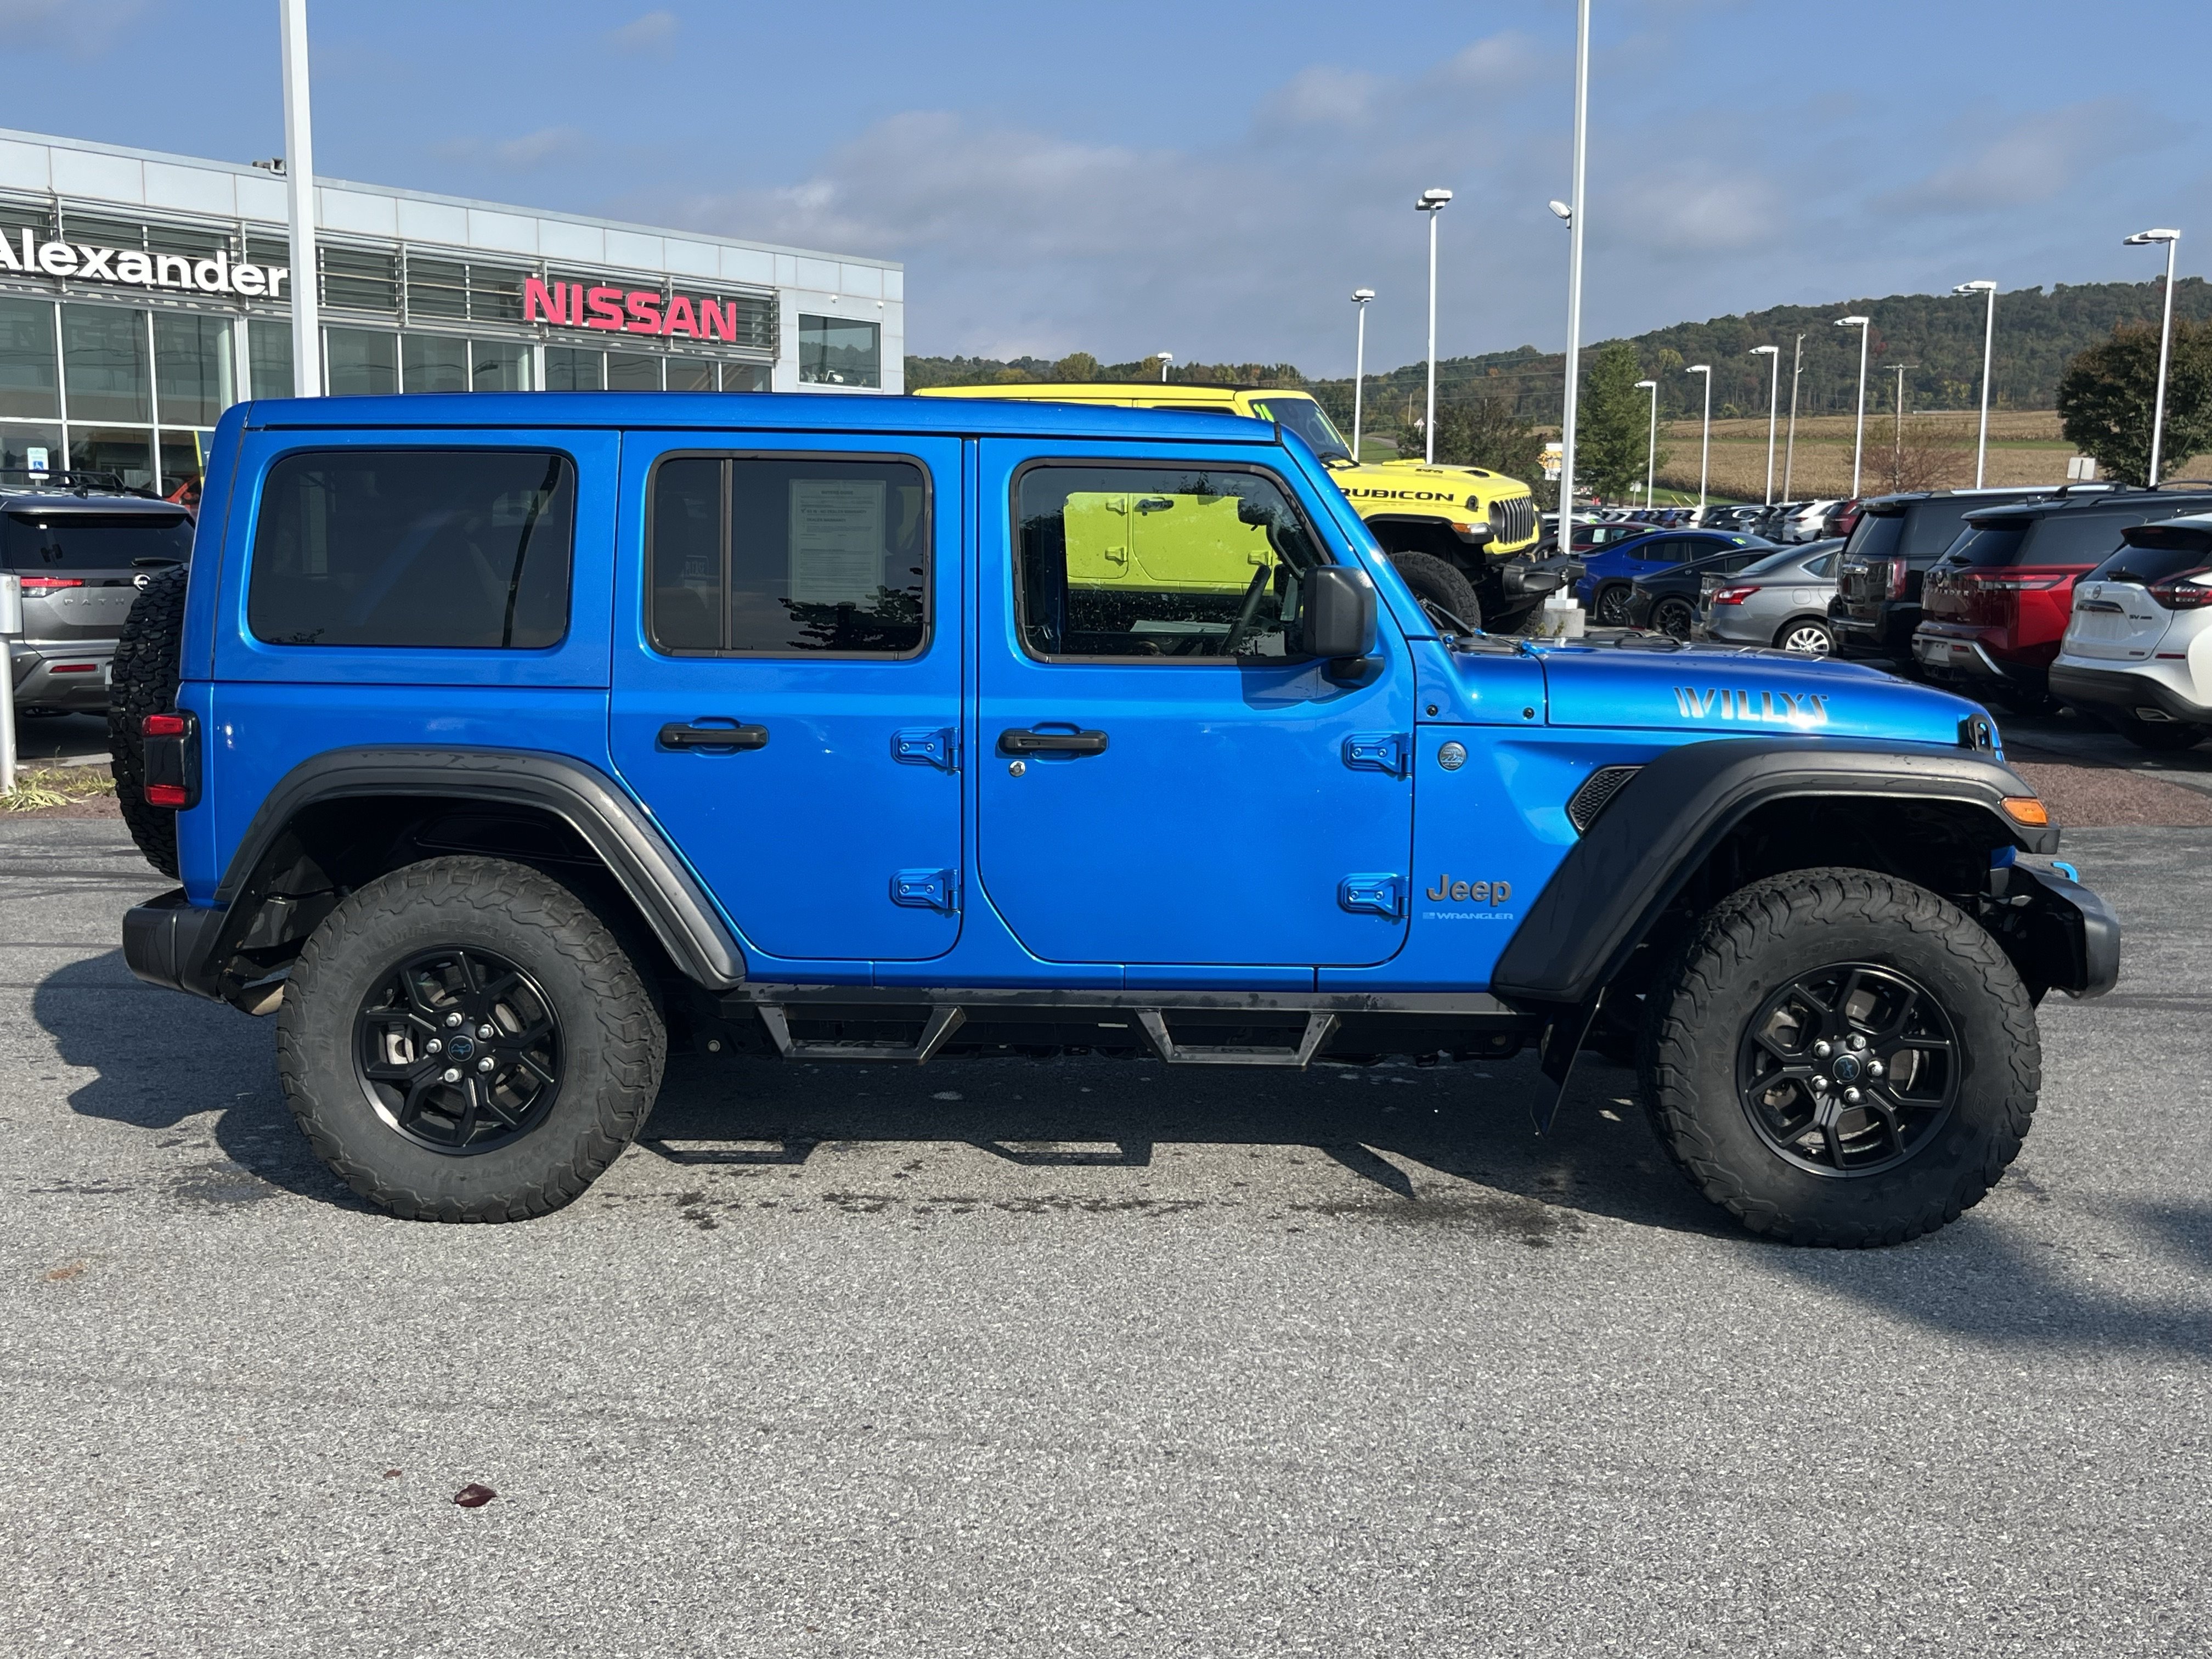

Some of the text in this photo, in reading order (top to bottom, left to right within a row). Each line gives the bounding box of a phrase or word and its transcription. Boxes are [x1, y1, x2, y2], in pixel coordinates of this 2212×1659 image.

[523, 277, 737, 342] NISSAN
[1339, 487, 1454, 501] RUBICON
[1673, 687, 1829, 724] WILLYS
[1426, 874, 1511, 907] Jeep
